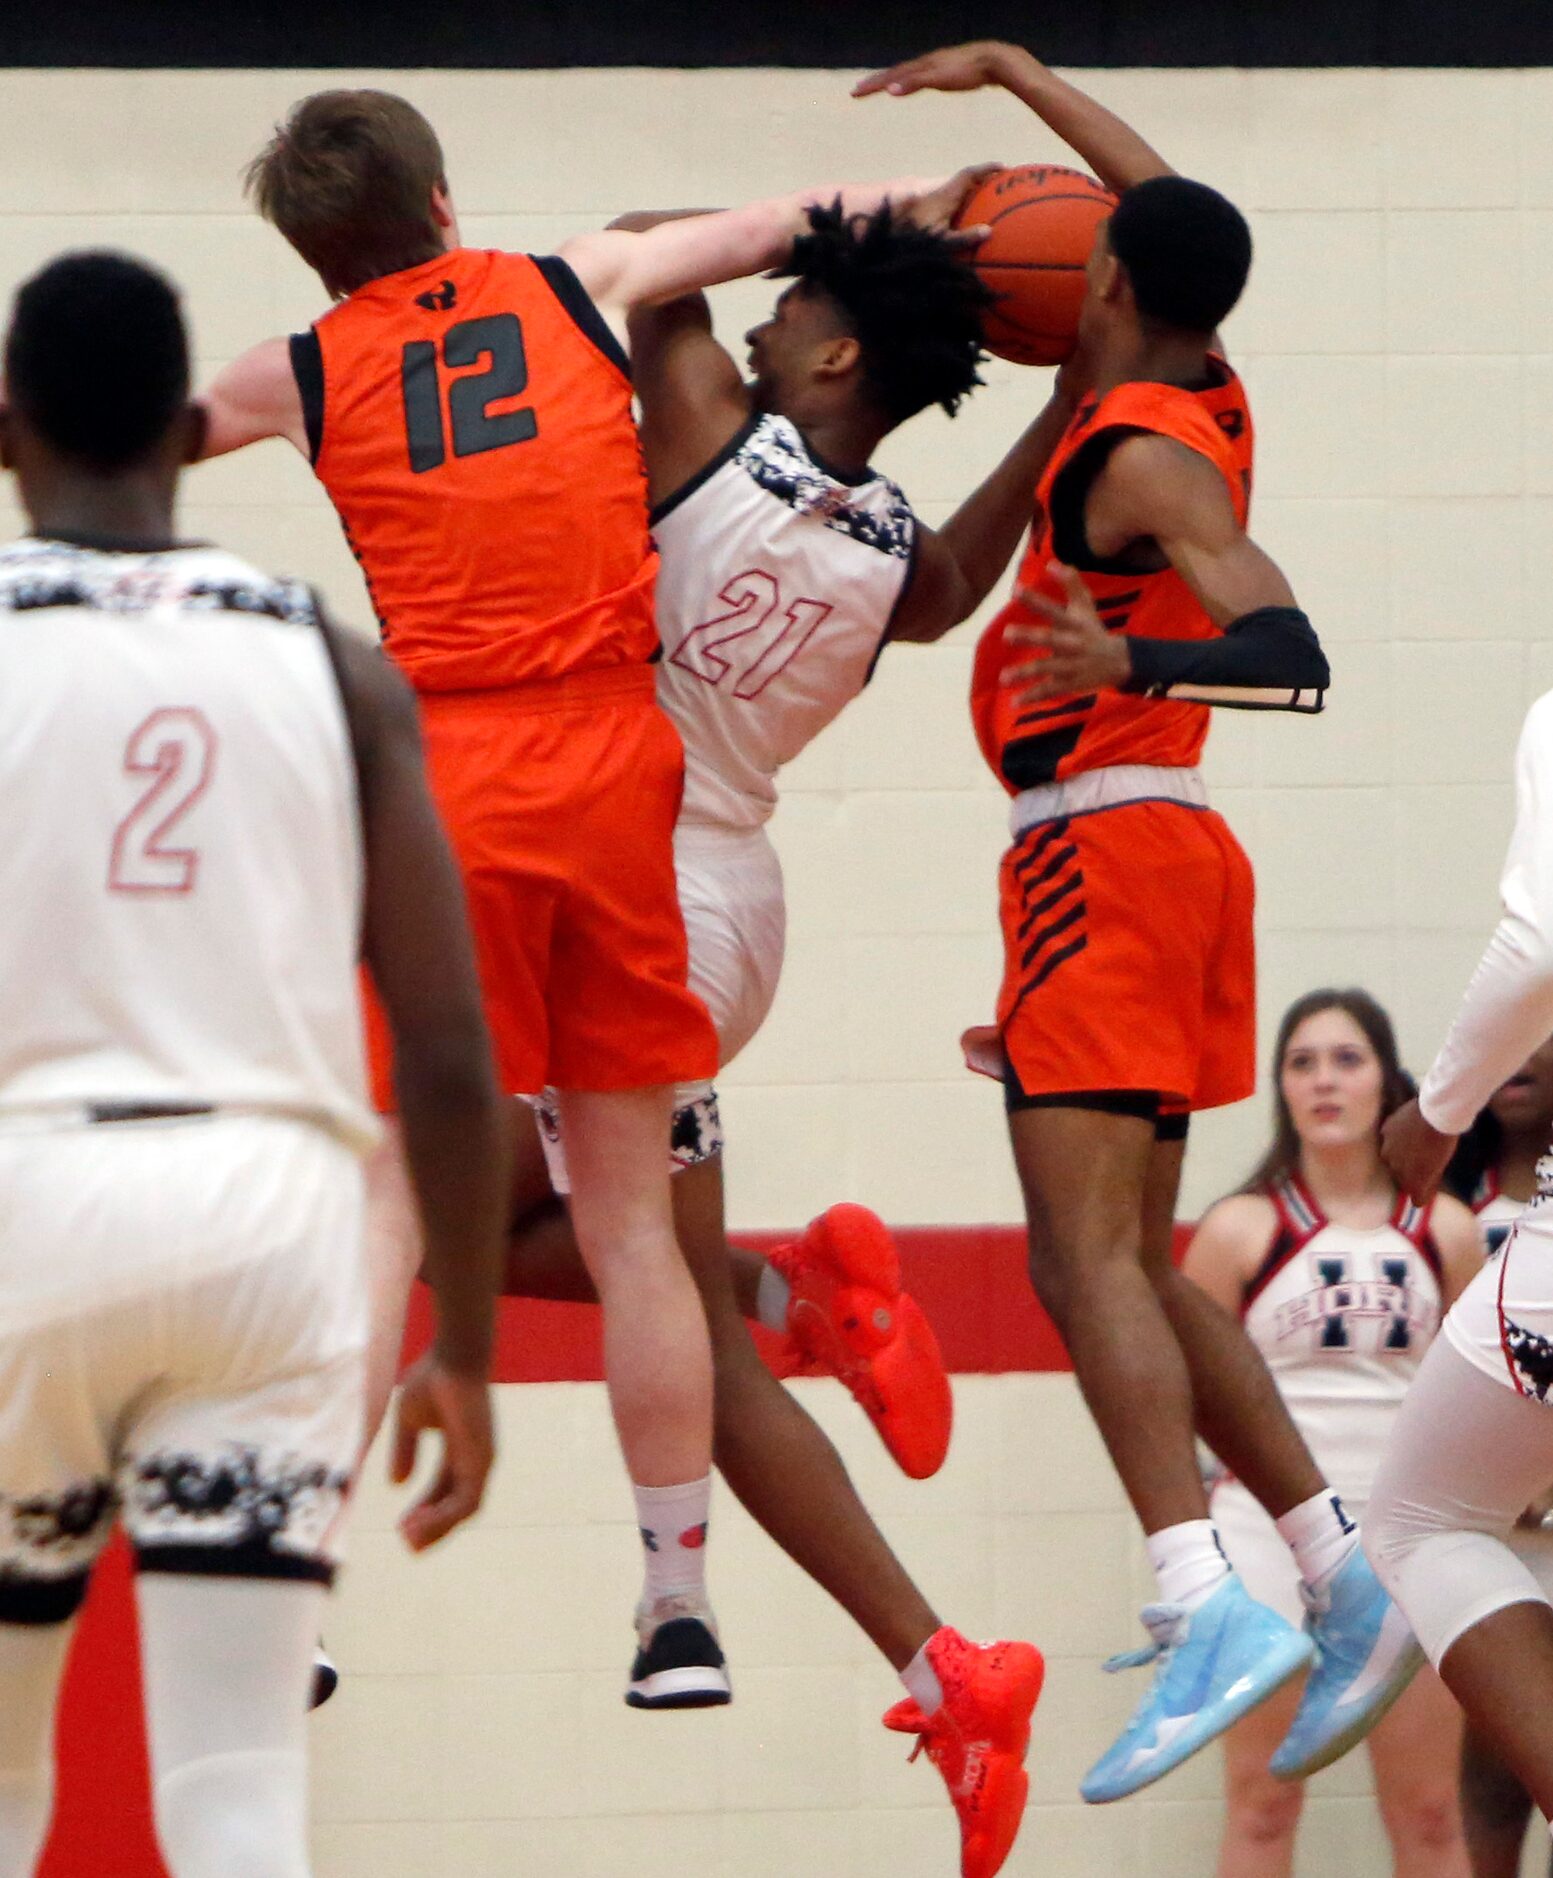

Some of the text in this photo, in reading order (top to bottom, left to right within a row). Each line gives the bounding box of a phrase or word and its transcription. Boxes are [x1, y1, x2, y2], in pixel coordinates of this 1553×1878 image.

[402, 313, 538, 474] 12
[669, 568, 834, 701] 21
[107, 704, 219, 894] 2
